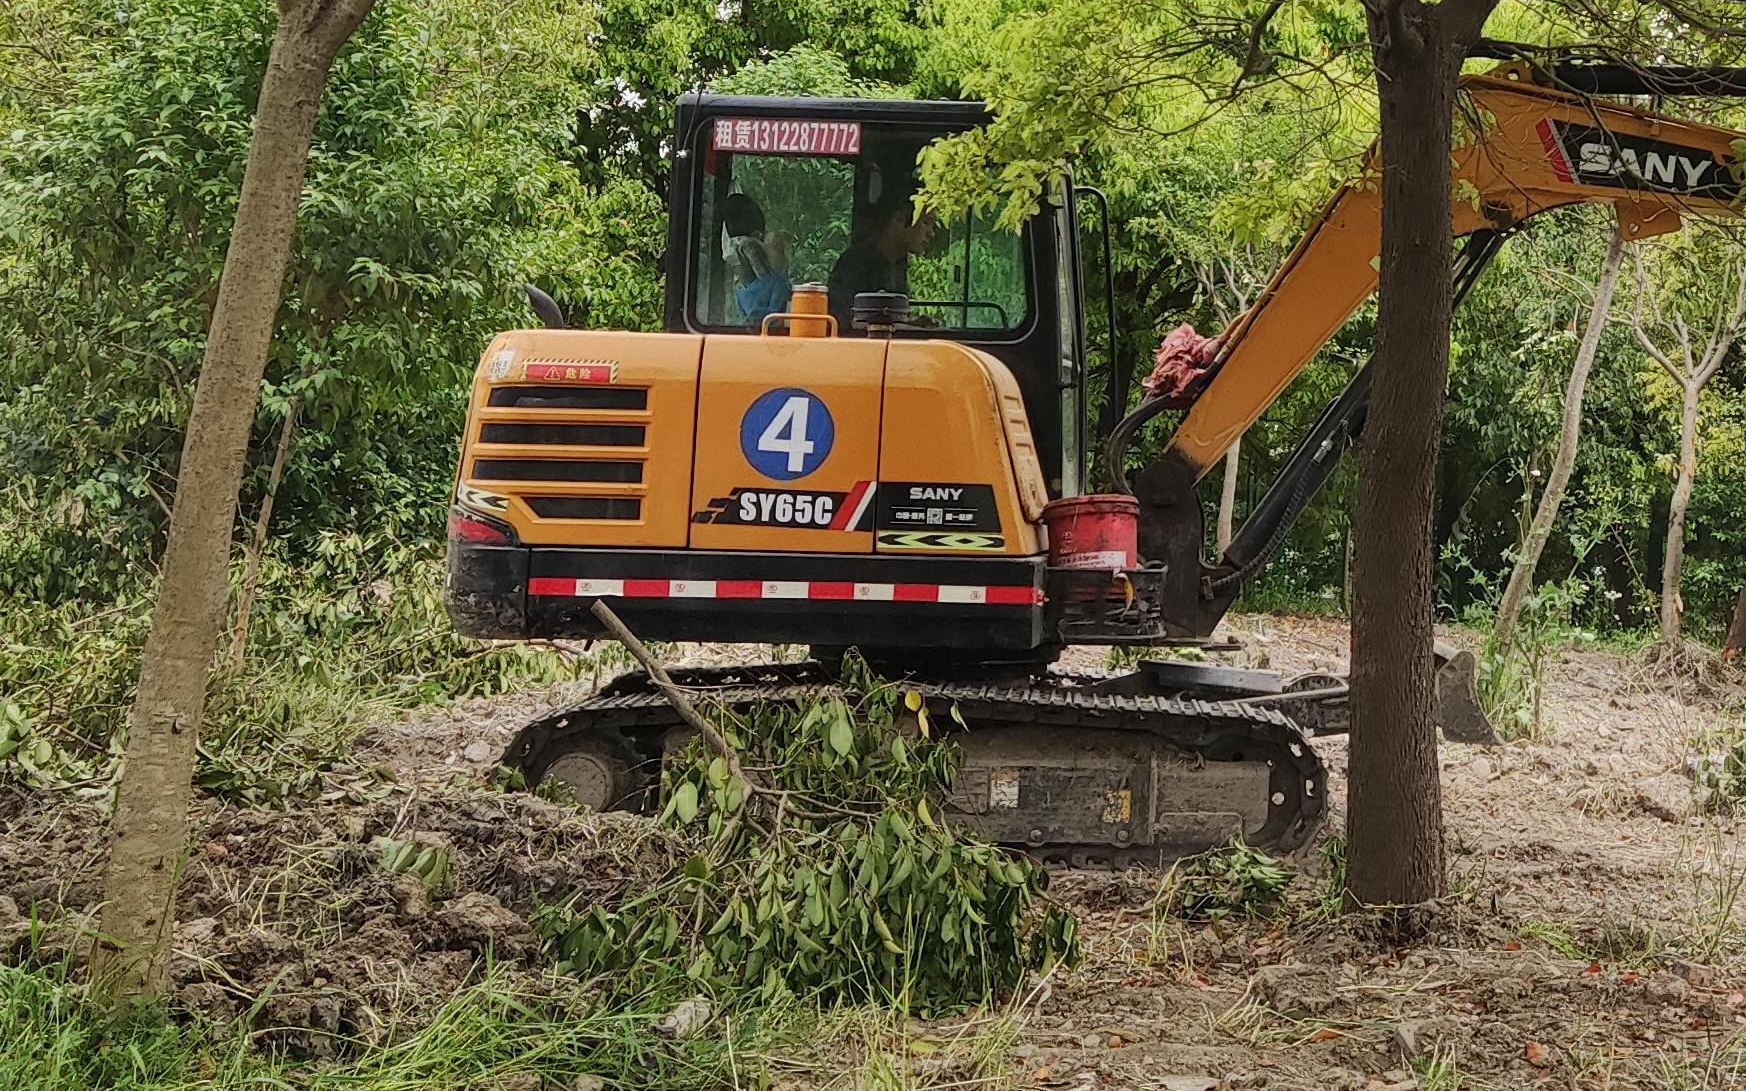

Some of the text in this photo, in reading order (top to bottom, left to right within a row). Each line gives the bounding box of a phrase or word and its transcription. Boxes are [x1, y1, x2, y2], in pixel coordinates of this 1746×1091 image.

[1579, 143, 1712, 187] SANY
[565, 367, 592, 380] 危险
[757, 396, 815, 473] 4
[739, 492, 833, 524] SY65C
[909, 487, 963, 500] SANY
